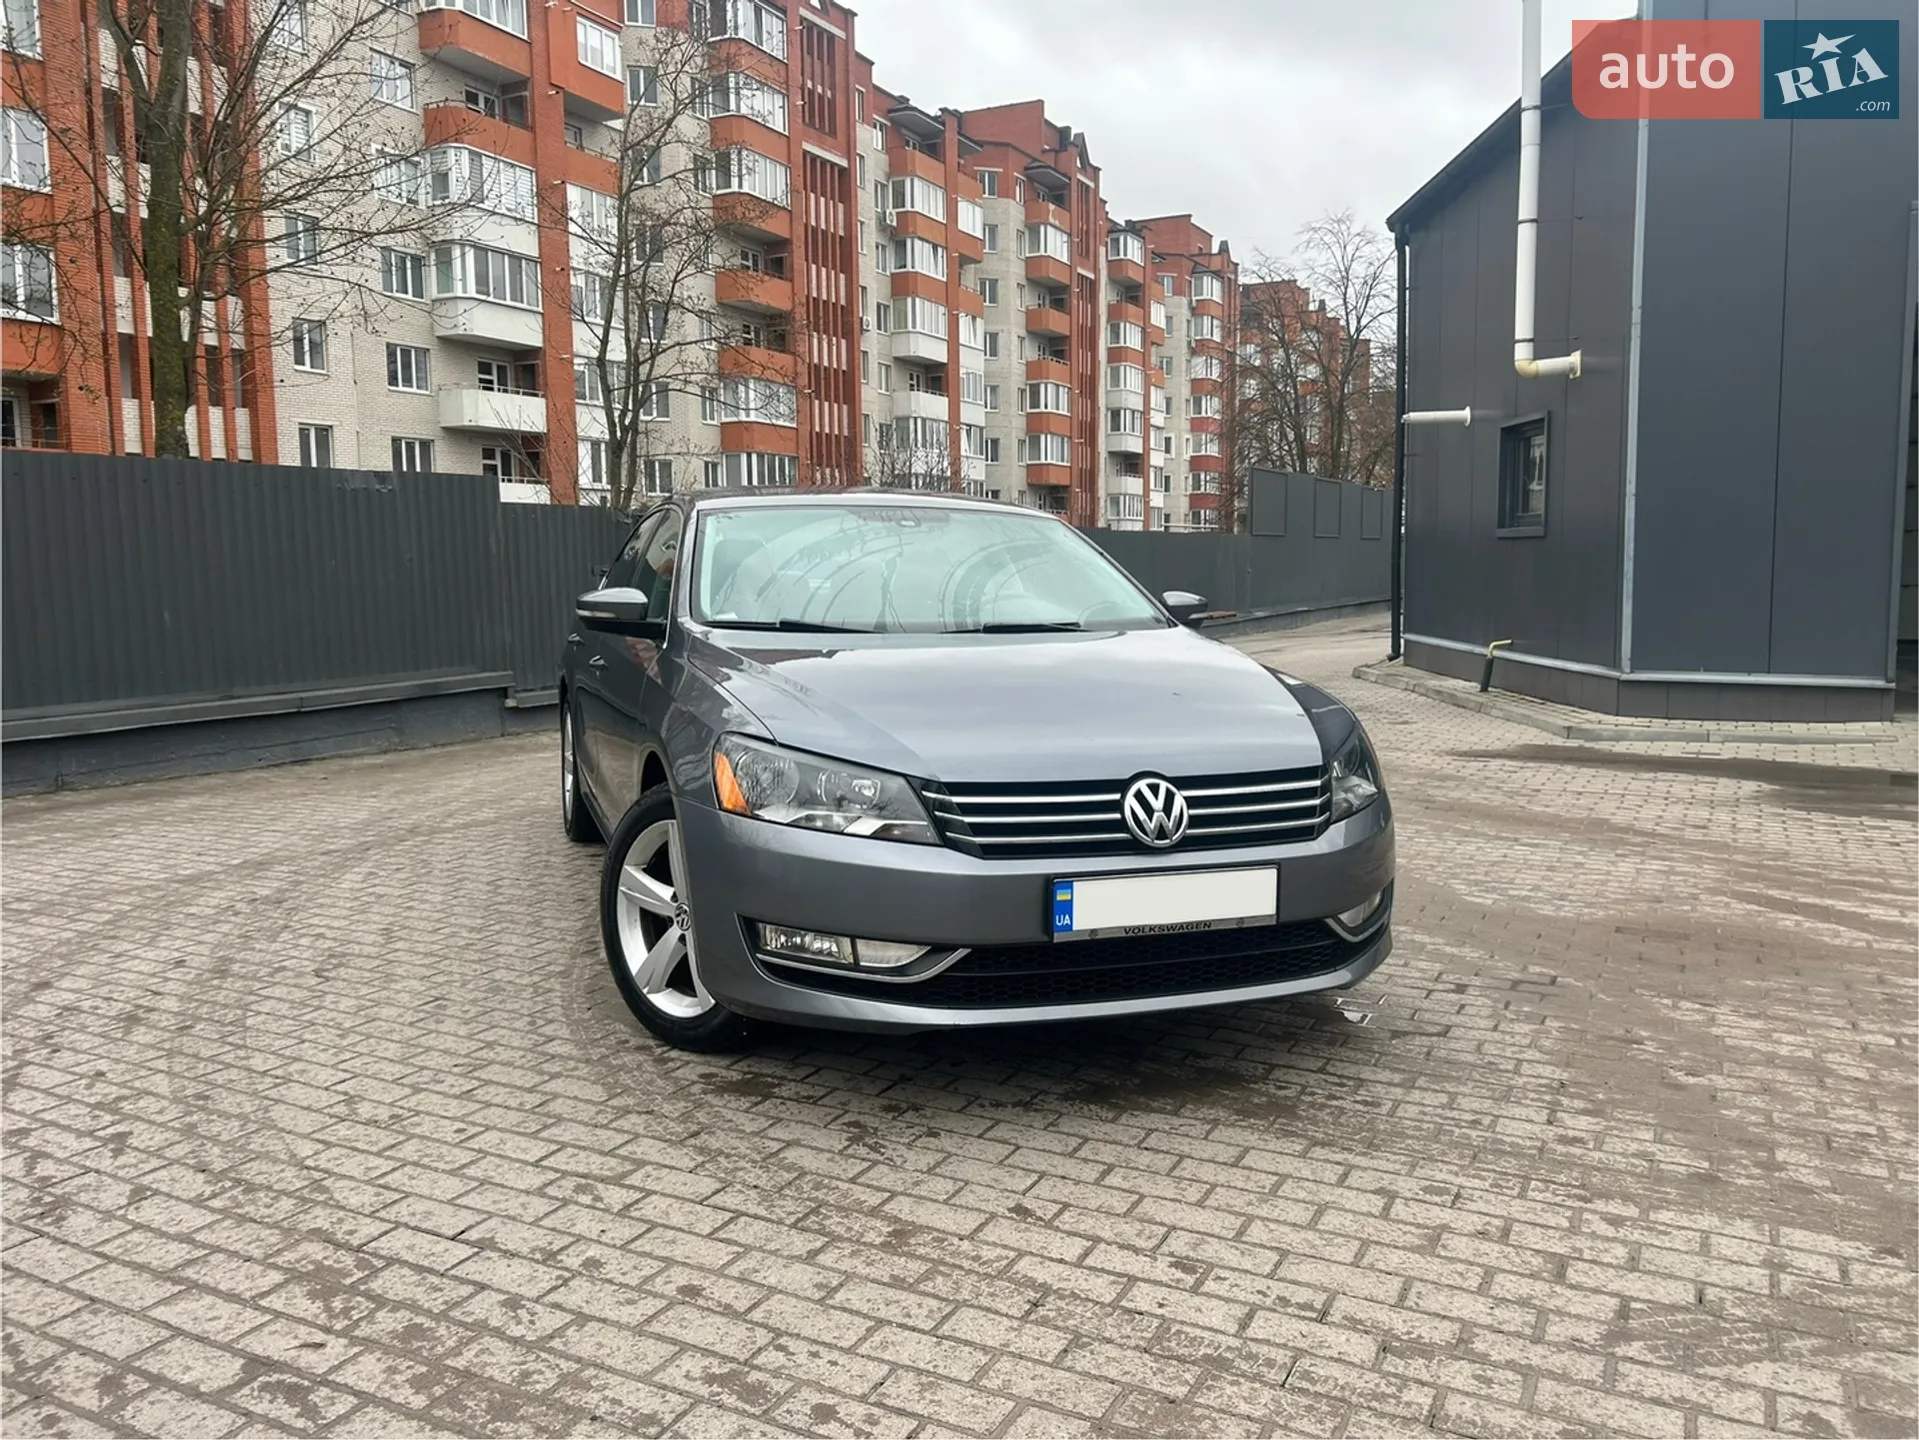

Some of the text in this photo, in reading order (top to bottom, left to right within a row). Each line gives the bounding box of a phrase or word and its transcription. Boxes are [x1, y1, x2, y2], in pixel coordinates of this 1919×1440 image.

[1124, 778, 1189, 847] VW
[1055, 914, 1071, 926] UA
[1123, 922, 1212, 935] VOLKSWAGEN
